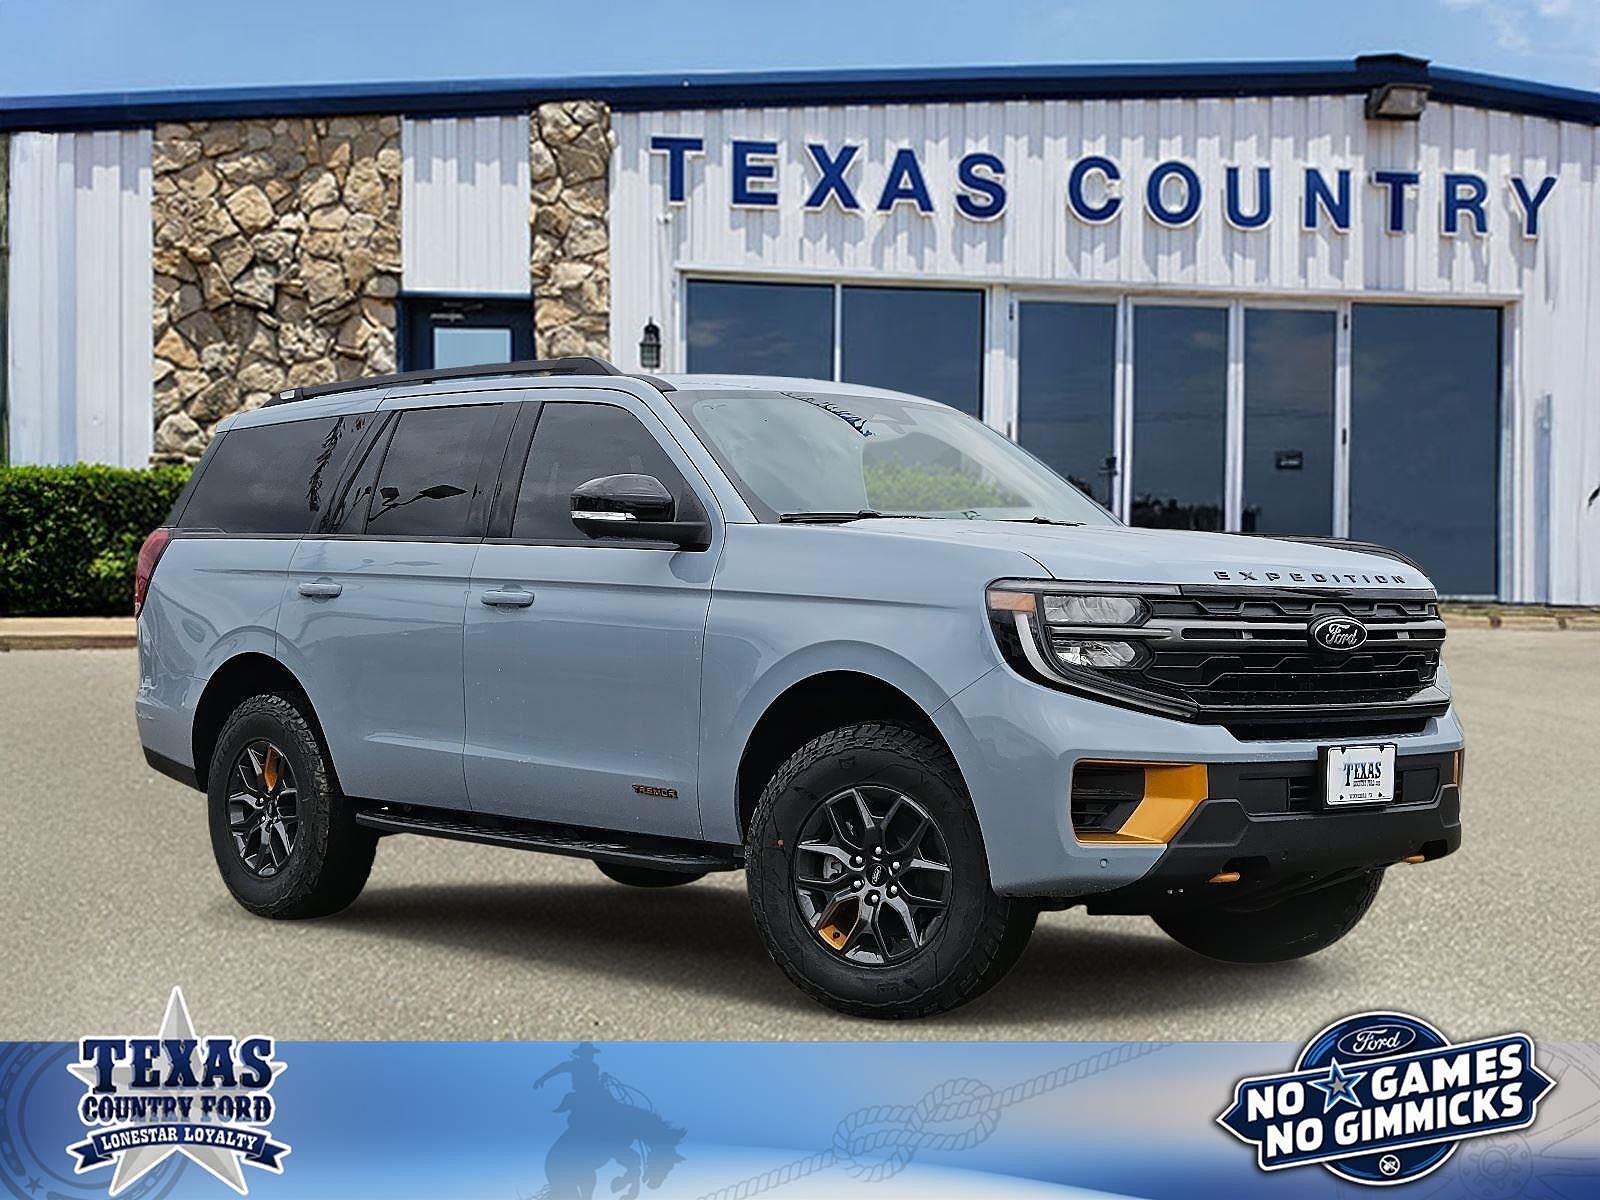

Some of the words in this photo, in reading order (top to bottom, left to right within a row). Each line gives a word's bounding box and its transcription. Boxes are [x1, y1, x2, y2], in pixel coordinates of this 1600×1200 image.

[650, 136, 1007, 222] TEXAS
[1067, 155, 1557, 239] COUNTRY
[1213, 570, 1406, 584] EXPEDITION
[1325, 623, 1358, 645] Ford
[1344, 762, 1381, 786] TEXAS
